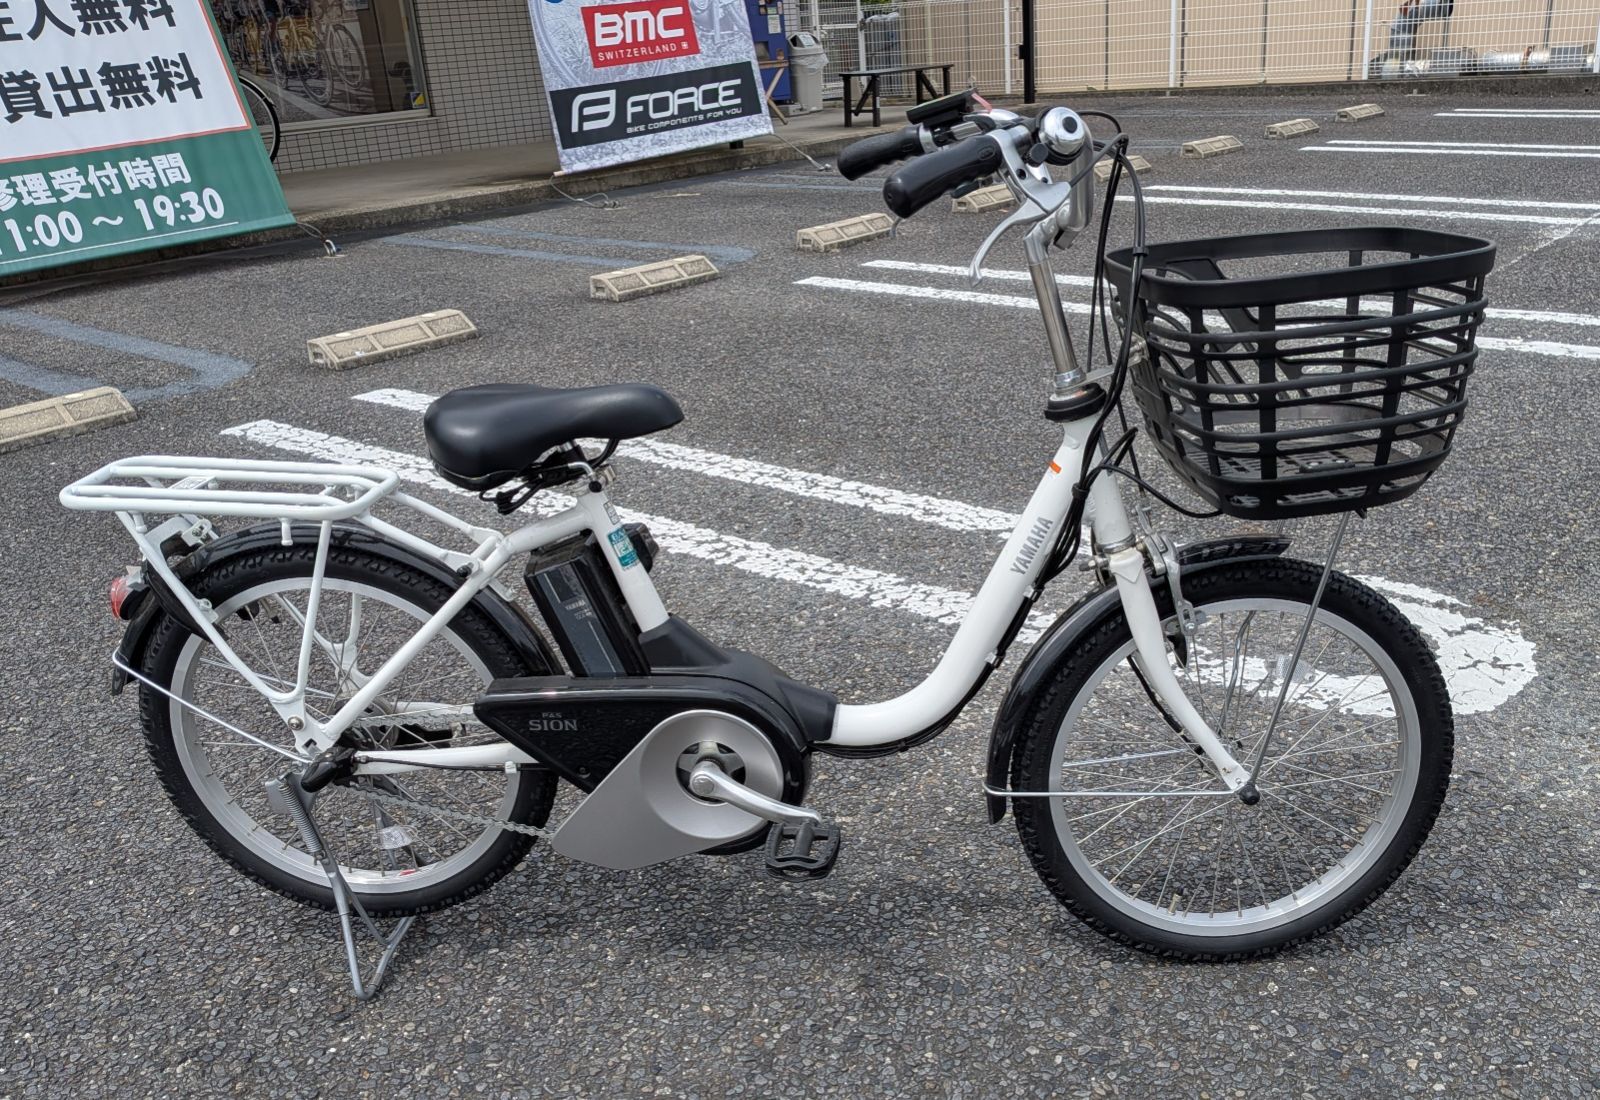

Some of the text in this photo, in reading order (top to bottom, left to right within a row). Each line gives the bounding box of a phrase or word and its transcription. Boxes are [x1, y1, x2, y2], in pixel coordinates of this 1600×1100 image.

[594, 6, 685, 47] BMC
[597, 42, 678, 61] SWITZERLAND
[0, 52, 203, 124] 貸出無料
[626, 78, 742, 124] FORCE
[626, 124, 646, 134] BIKE
[706, 111, 724, 120] FOR
[725, 107, 743, 116] YOU
[0, 210, 83, 255] 1:00
[134, 186, 225, 231] 19:30
[1010, 516, 1053, 575] YAMAHA
[528, 719, 578, 731] SION
[541, 711, 562, 719] PAS
